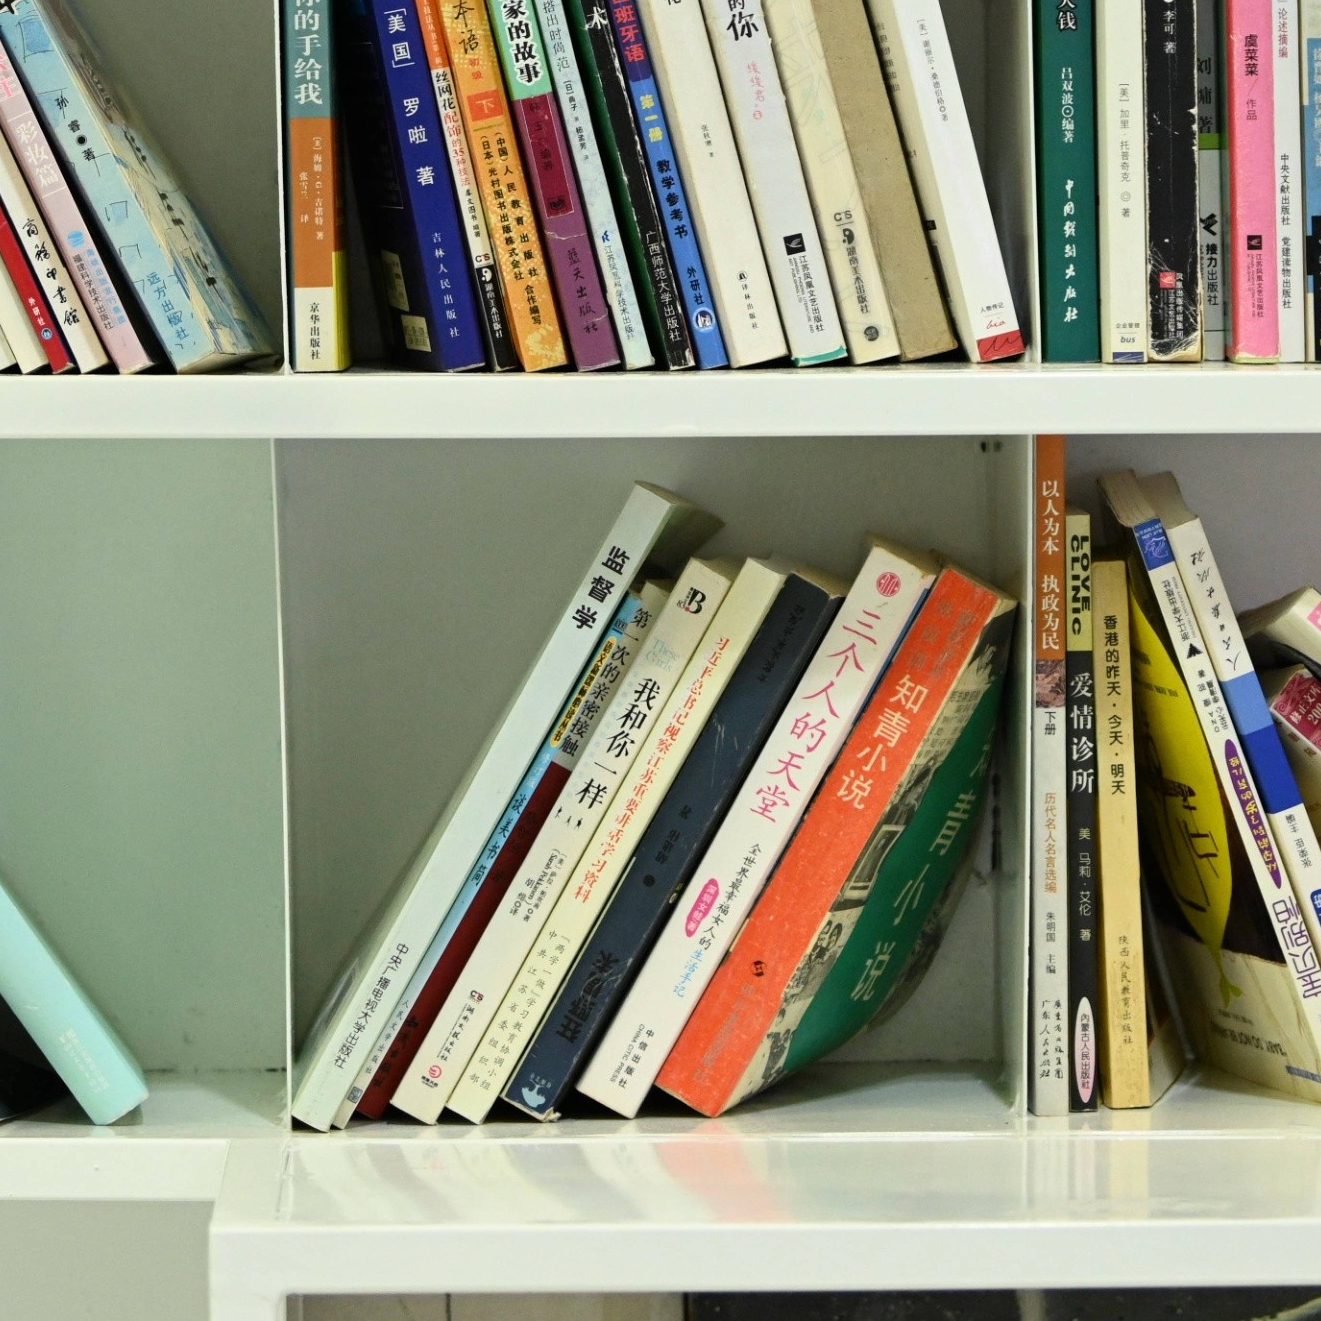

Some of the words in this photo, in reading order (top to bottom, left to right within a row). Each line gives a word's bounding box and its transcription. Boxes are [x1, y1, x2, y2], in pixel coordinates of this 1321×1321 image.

[656, 158, 688, 239] 教学参考书
[309, 303, 321, 360] 京华出版社
[431, 233, 460, 338] 吉林人民出版社
[1041, 480, 1060, 556] 以人为本
[572, 545, 631, 631] 监督学
[1041, 575, 1060, 651] 执政为民
[1070, 534, 1082, 636] CLINIC
[1079, 535, 1090, 612] LOVE
[575, 677, 661, 810] 我和你一样
[749, 608, 885, 823] 三个人的天堂
[834, 675, 929, 811] 知青小说
[1070, 673, 1095, 794] 爱情诊所
[1045, 793, 1057, 894] 历代名人名言选编
[333, 942, 410, 1070] 中央广播电视大学出版社
